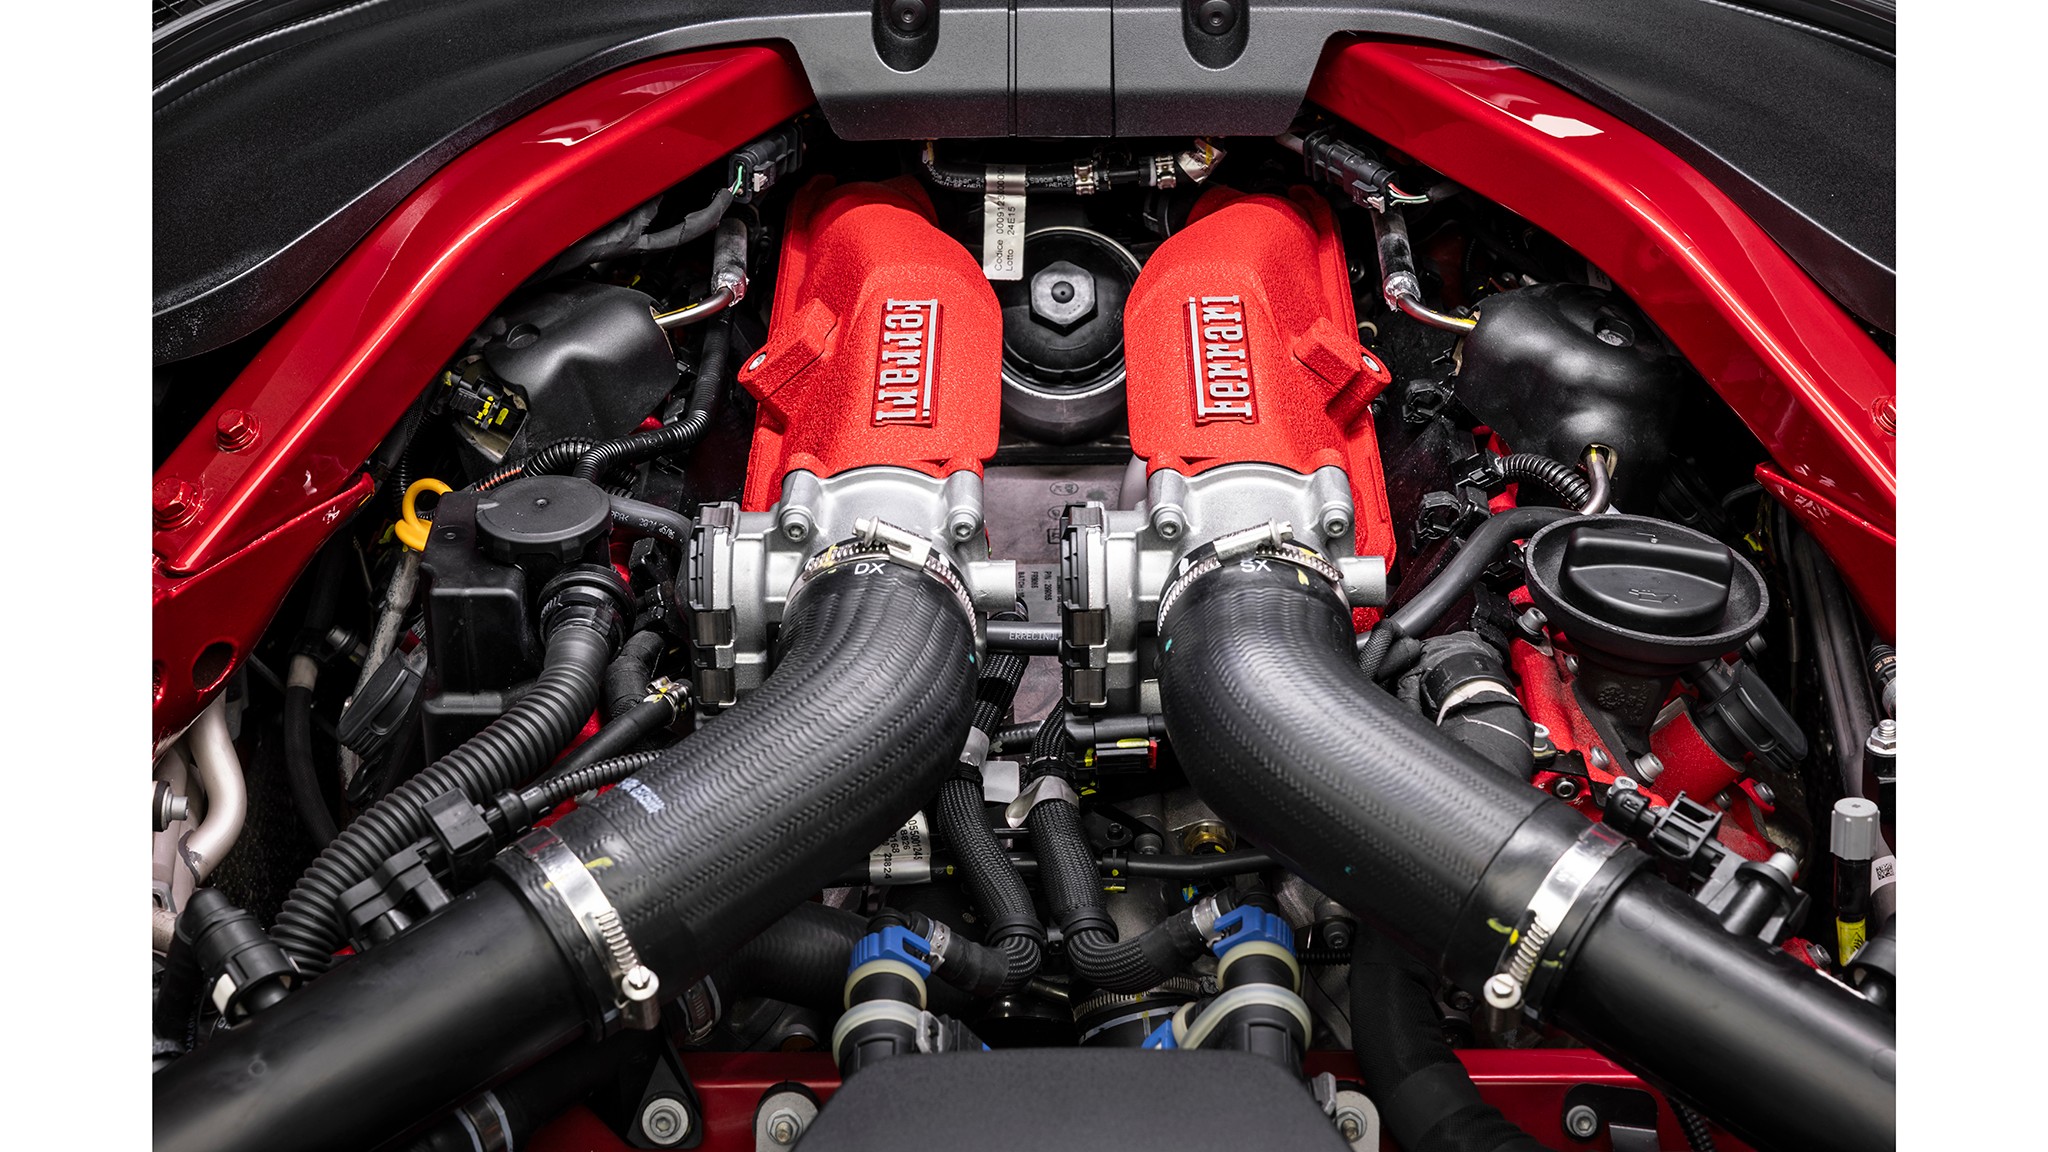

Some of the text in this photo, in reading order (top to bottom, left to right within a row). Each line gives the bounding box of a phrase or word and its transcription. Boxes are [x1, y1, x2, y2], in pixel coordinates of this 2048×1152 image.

[994, 239, 1004, 272] Codice
[1006, 206, 1016, 272] Lotto 24E15
[876, 298, 938, 421] Ferrari
[1189, 295, 1252, 418] Ferrari
[854, 562, 886, 575] DX
[1239, 559, 1272, 573] SX
